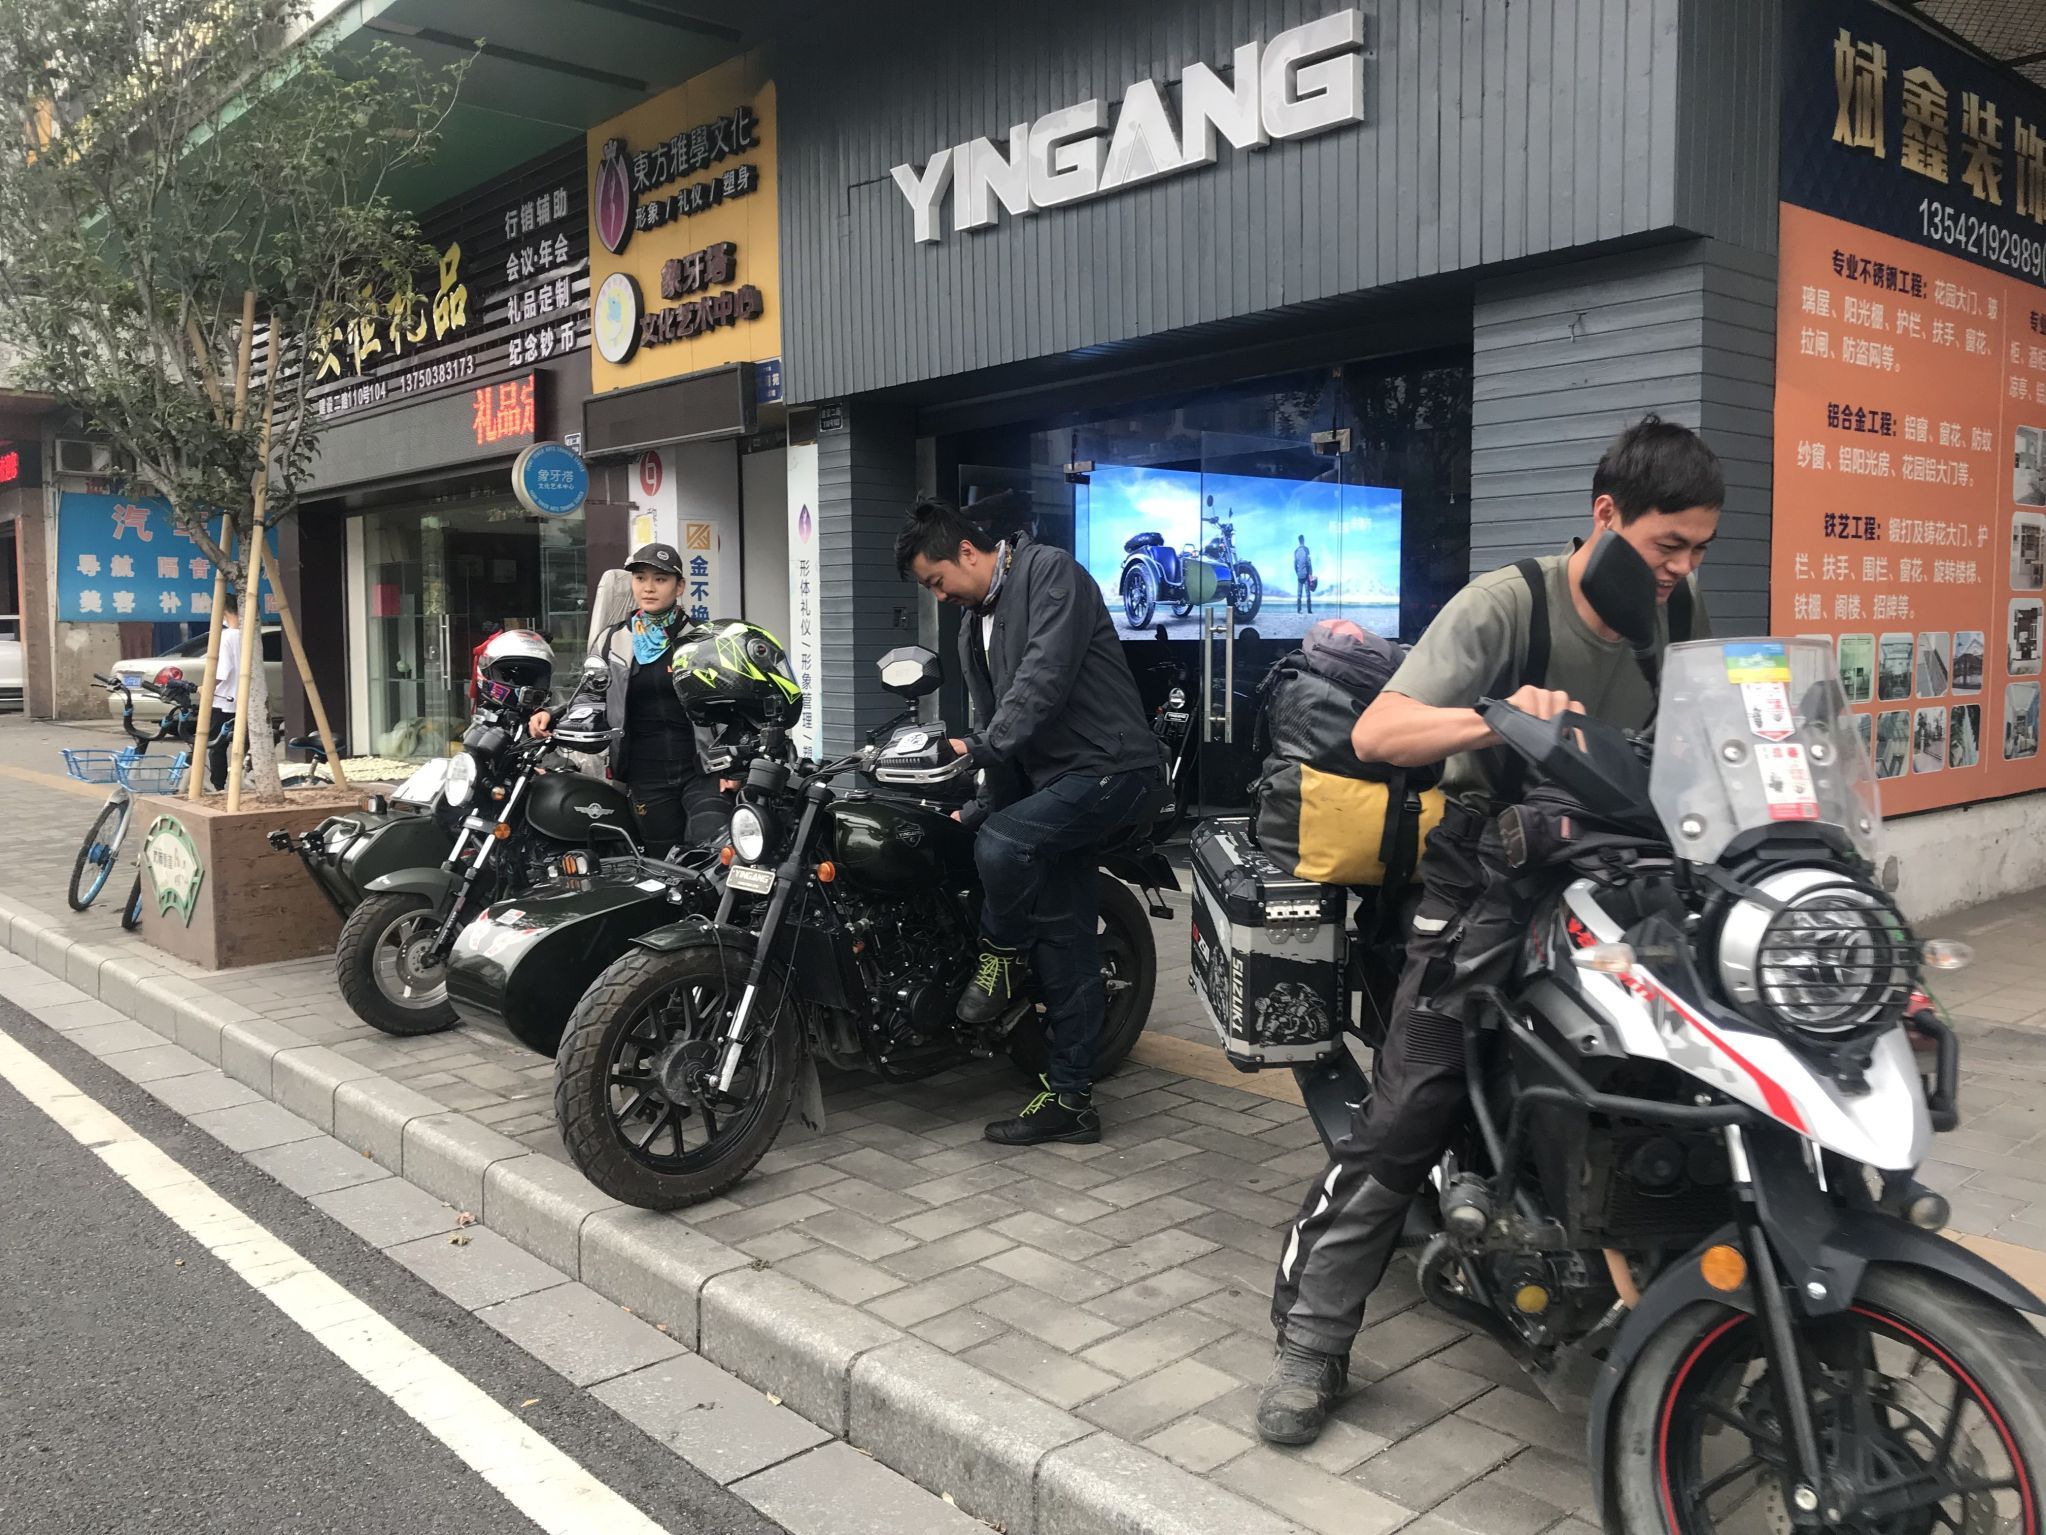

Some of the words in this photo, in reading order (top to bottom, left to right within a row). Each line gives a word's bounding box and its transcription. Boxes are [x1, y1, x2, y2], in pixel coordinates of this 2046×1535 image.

[890, 8, 1364, 243] YINGANG
[504, 187, 568, 240] 行销辅助
[507, 276, 572, 325] 礼品定制
[507, 321, 575, 367] 纪念钞币
[400, 355, 476, 394] 13750383173
[537, 469, 575, 483] 象牙塔
[735, 868, 770, 884] YINGANG
[1232, 956, 1244, 1034] SUZUKI
